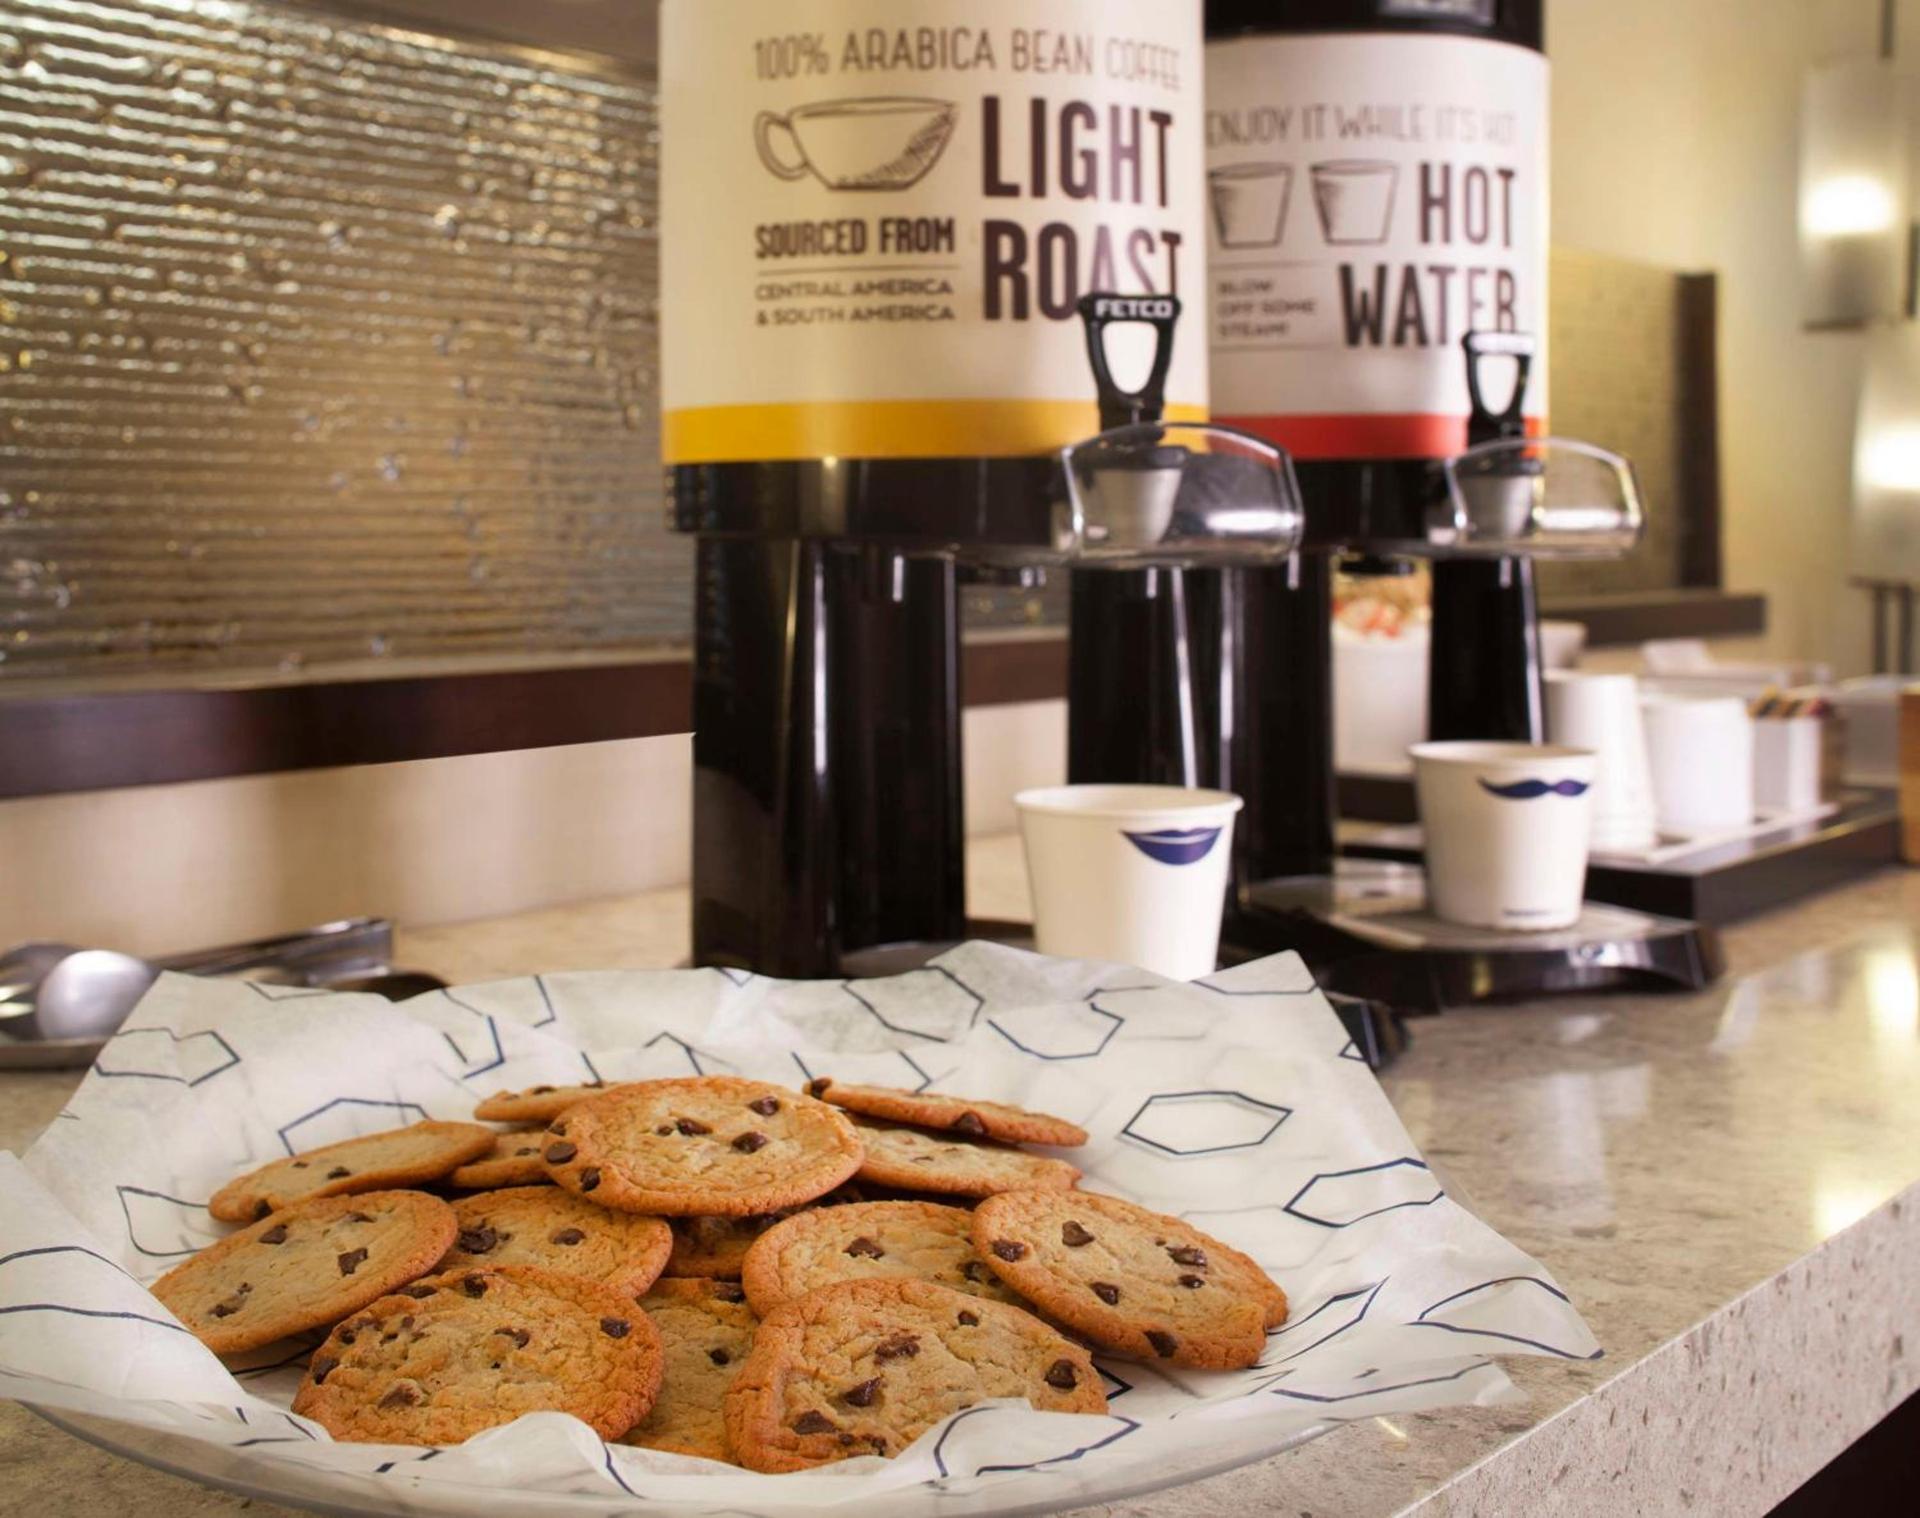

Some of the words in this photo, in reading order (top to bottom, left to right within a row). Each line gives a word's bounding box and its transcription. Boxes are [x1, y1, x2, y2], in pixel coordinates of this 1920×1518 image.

[754, 33, 829, 79] 100%
[840, 27, 997, 71] ARABICA
[1010, 29, 1093, 75] BEAN
[1105, 37, 1181, 90] COFFEE
[983, 96, 1172, 207] LIGHT
[1420, 162, 1515, 247] HOT
[755, 218, 867, 259] SOURCED
[879, 217, 955, 254] FROM
[984, 219, 1181, 320] ROAST
[755, 281, 847, 301] CENTRAL
[852, 278, 953, 296] AMERICA
[757, 310, 768, 325] &
[773, 306, 845, 325] SOUTH
[850, 304, 955, 322] AMERICA
[1095, 299, 1174, 318] FETCO
[1339, 263, 1516, 346] WATER
